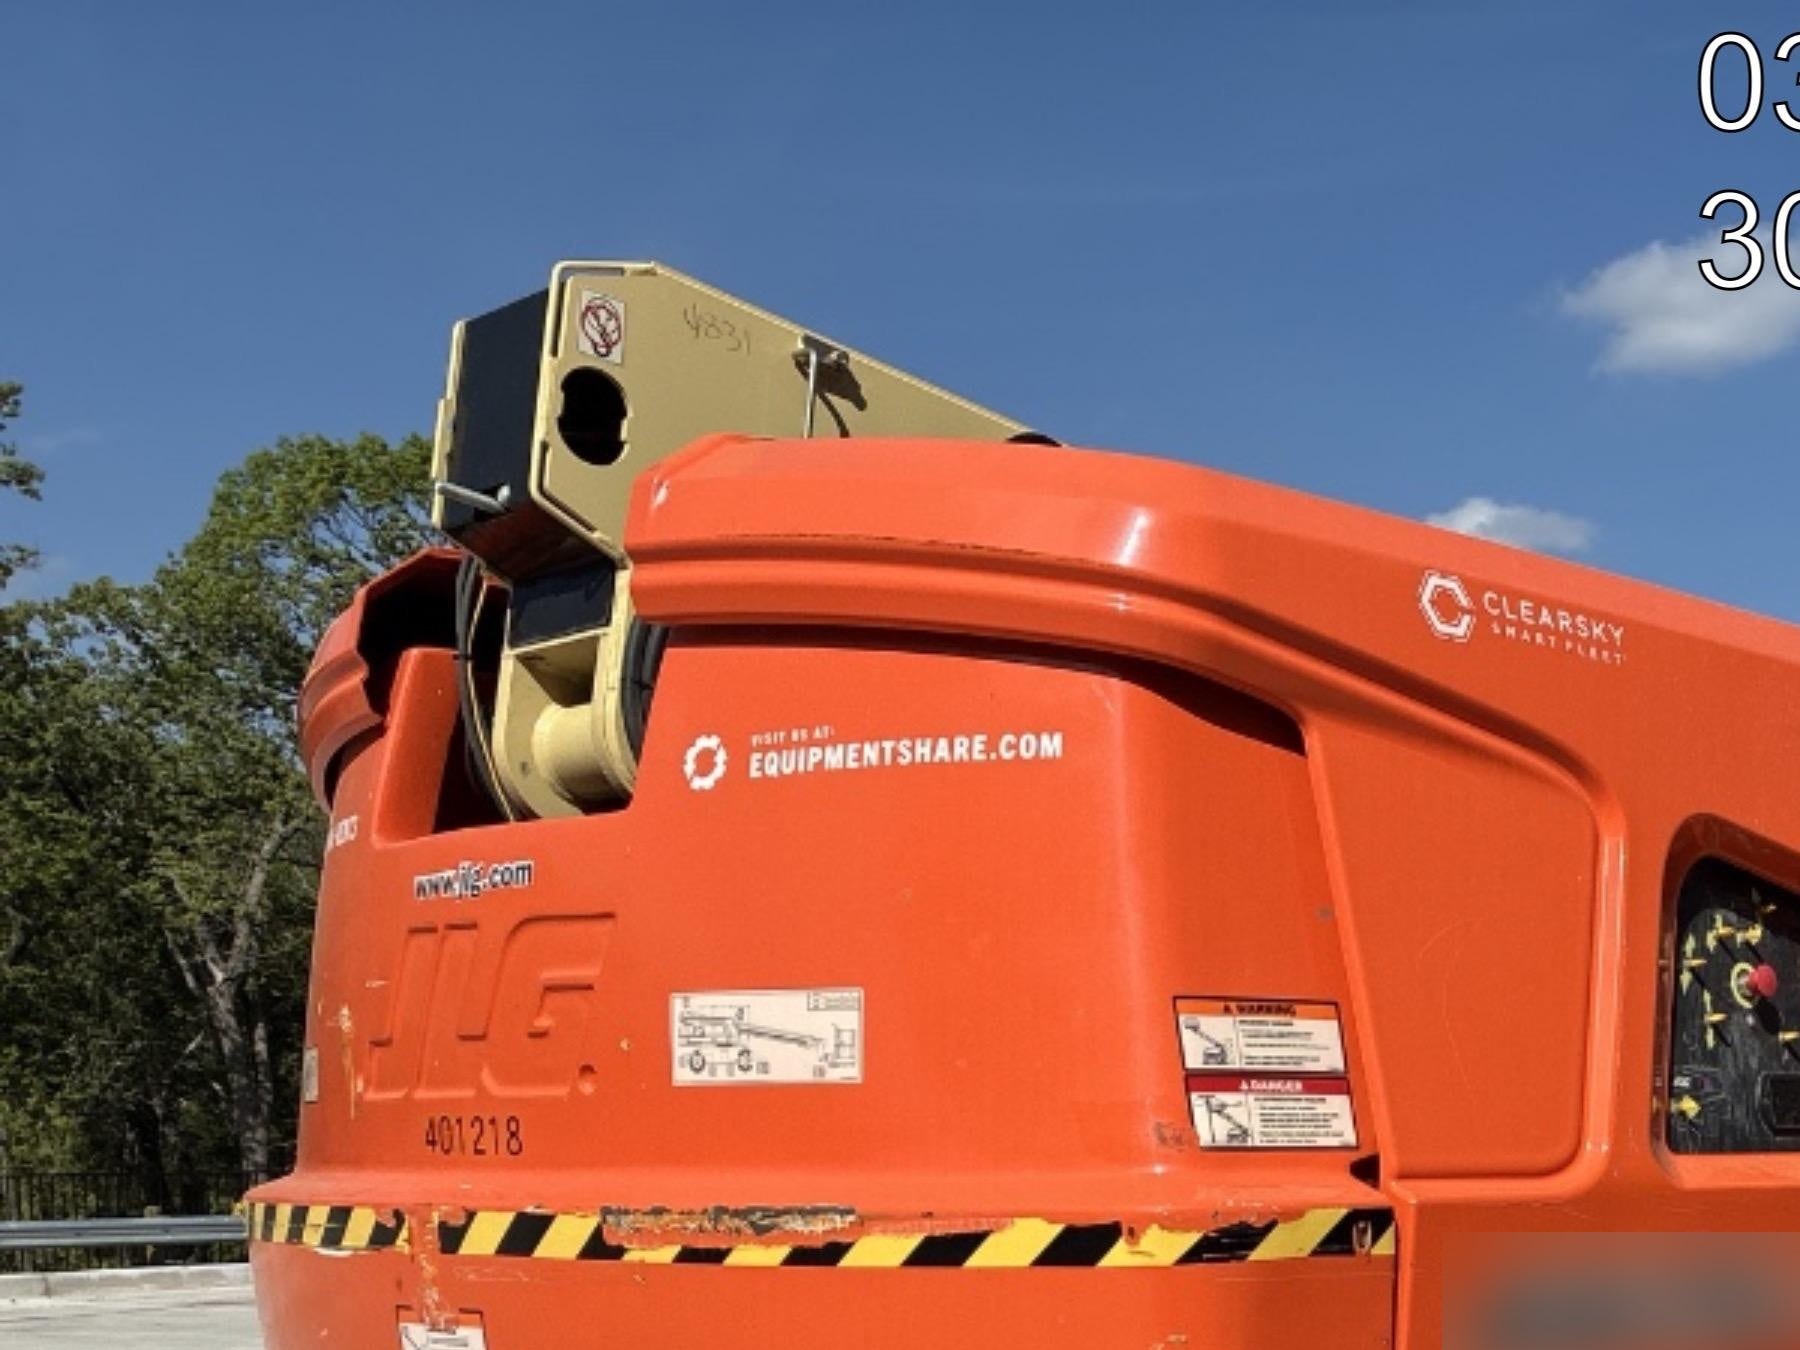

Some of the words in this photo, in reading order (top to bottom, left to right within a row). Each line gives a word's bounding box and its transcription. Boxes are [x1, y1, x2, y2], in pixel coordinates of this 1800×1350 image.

[1482, 591, 1625, 647] CLEARSKY
[1490, 621, 1556, 649] SMART
[748, 731, 1064, 779] EQUIPMENTSHARE.COM
[751, 730, 786, 748] VISIT
[414, 860, 534, 901] www.jlg.com
[424, 1114, 524, 1156] 401218
